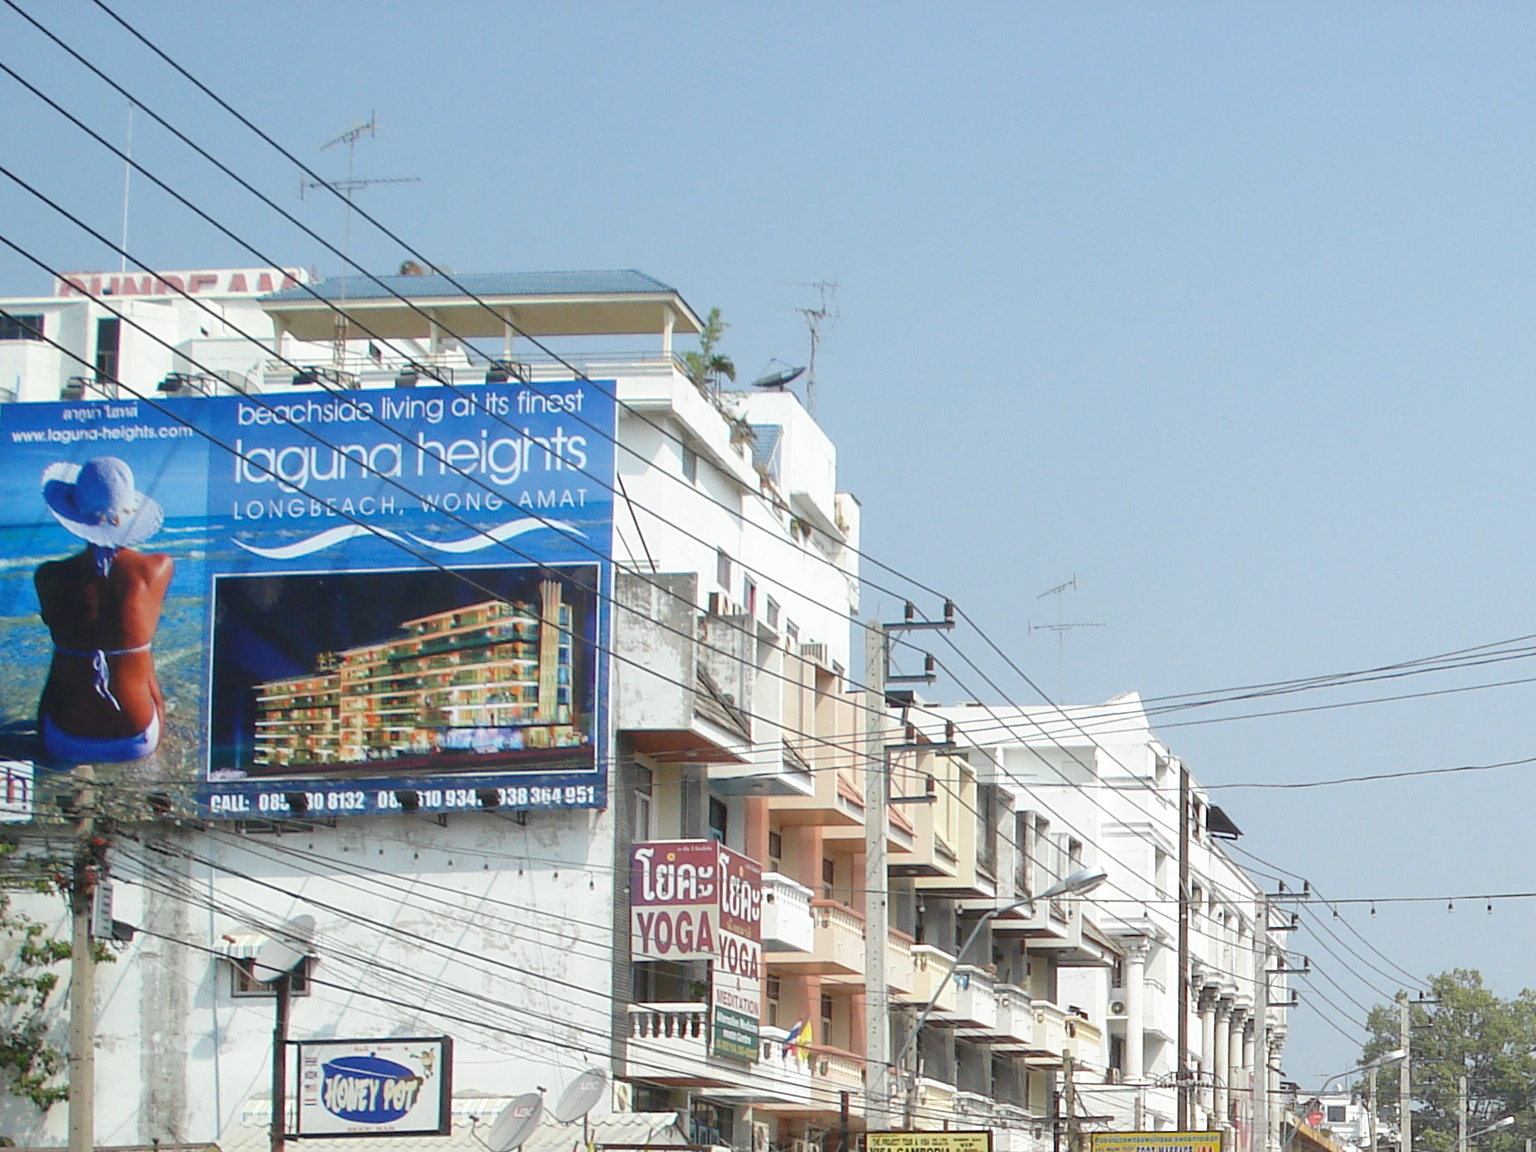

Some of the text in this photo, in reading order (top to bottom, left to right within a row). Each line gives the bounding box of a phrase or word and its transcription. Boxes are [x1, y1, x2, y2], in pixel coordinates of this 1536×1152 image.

[238, 388, 584, 426] beachside living at its finest
[11, 424, 194, 446] www.laguna-heights.com
[234, 425, 588, 493] laguna heights
[233, 488, 588, 521] LONGBEACH, WONG AMAT
[210, 794, 250, 813] CALL:
[327, 791, 366, 810] 8132
[530, 786, 562, 806] 364
[565, 785, 595, 804] 951
[636, 910, 715, 955] YOGA
[718, 932, 759, 983] YOGA
[716, 988, 759, 1015] MEDITATION
[322, 1073, 418, 1114] HONEY POT
